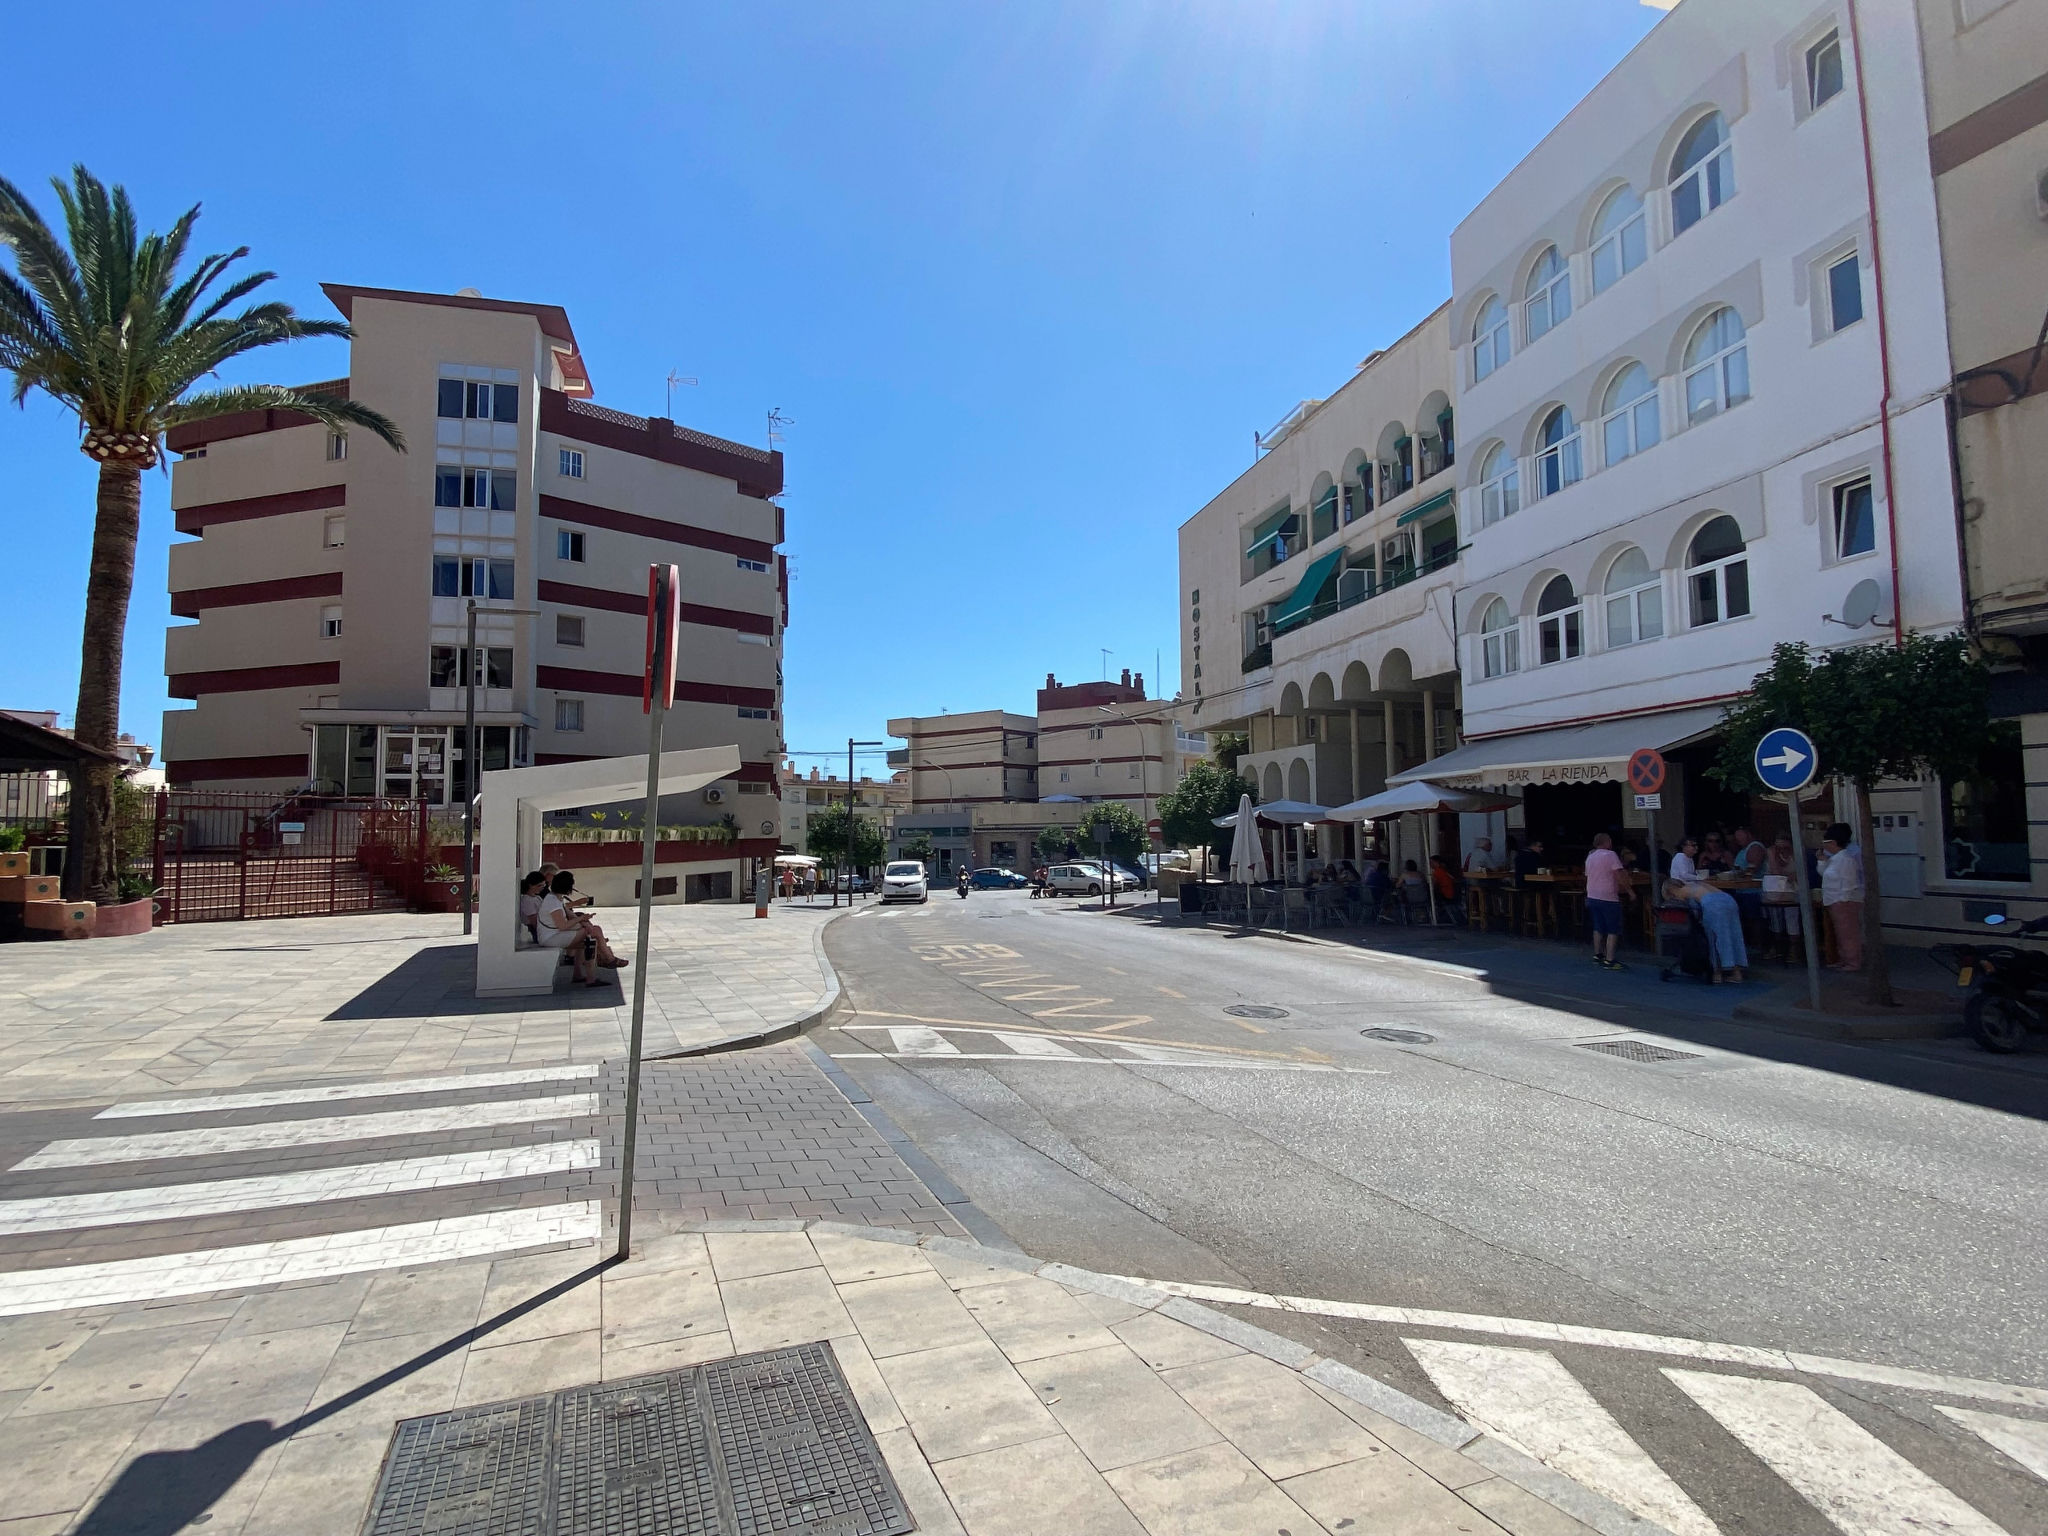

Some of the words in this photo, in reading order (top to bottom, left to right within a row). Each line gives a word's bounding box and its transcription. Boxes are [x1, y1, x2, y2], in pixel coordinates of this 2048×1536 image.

[1507, 769, 1529, 781] BAR
[1542, 768, 1557, 780] LA
[1561, 765, 1609, 780] RIENDA
[909, 944, 1024, 961] BUS
